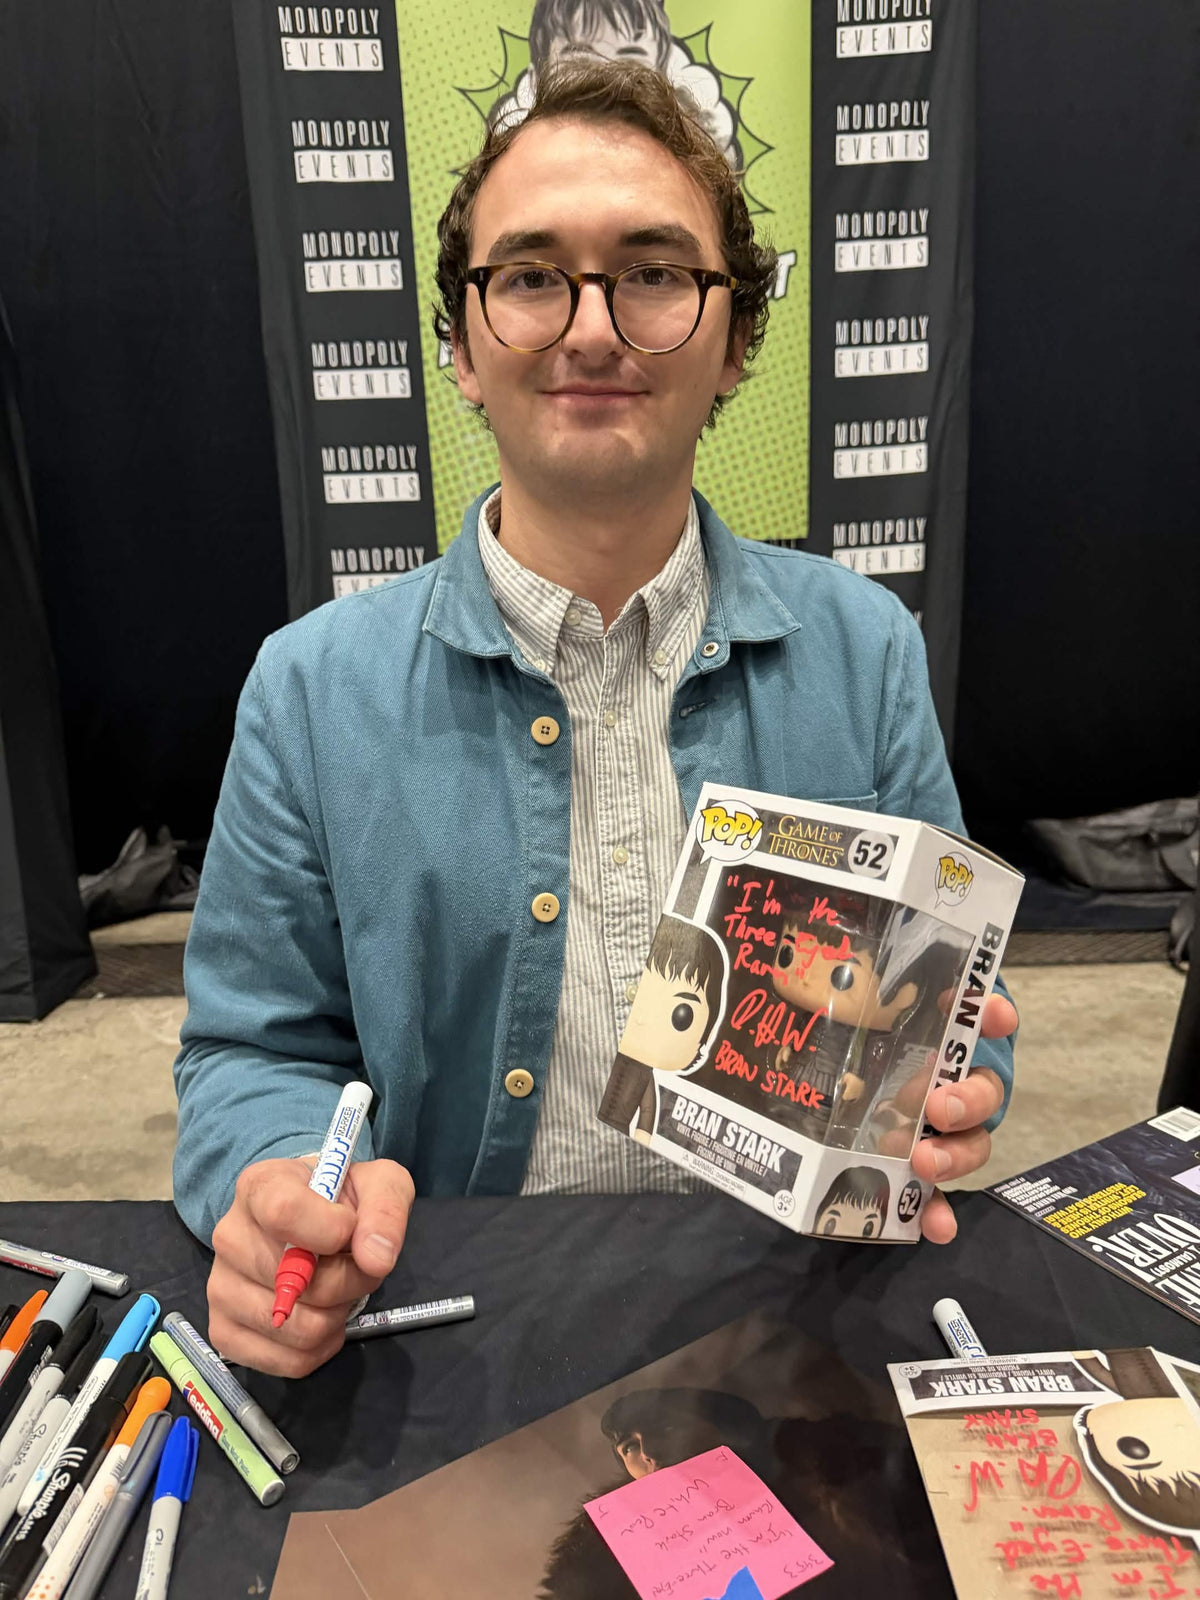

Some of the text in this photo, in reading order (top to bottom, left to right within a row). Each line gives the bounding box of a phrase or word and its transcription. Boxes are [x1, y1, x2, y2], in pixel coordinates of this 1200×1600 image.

[278, 6, 380, 34] MONOPOLY
[840, 24, 928, 54] EVENTS
[284, 41, 380, 67] EVENTS
[836, 101, 929, 131] MONOPOLY
[291, 120, 390, 147] MONOPOLY
[839, 134, 925, 162] EVENTS
[297, 154, 391, 179] EVENTS
[835, 209, 928, 239] MONOPOLY
[302, 231, 399, 258] MONOPOLY
[838, 241, 924, 268] EVENTS
[308, 264, 400, 289] EVENTS
[835, 316, 929, 346] MONOPOLY
[311, 340, 408, 368] MONOPOLY
[838, 346, 924, 375] EVENTS
[317, 372, 408, 397] EVENTS
[834, 416, 928, 448] MONOPOLY
[321, 446, 417, 472] MONOPOLY
[836, 448, 923, 476] EVENTS
[327, 476, 418, 498] EVENTS
[833, 518, 926, 547] MONOPOLY
[331, 547, 424, 572] MONOPOLY
[700, 806, 762, 850] POP!
[778, 816, 844, 844] GAME OF
[768, 832, 842, 867] THRONES
[852, 840, 887, 870] 52
[938, 856, 974, 896] POP!
[955, 922, 1004, 1029] BRAN
[715, 1040, 824, 1110] BRAN STARK
[338, 1106, 354, 1138] MARKER
[671, 1096, 786, 1173] BRAN STARK
[778, 1190, 794, 1206] AGE
[778, 1201, 788, 1213] 3+
[899, 1188, 920, 1216] 52
[1081, 1182, 1127, 1206] WESTEROS
[1108, 1190, 1147, 1211] SEASONS
[1060, 1211, 1100, 1234] THRONES
[1068, 1205, 1133, 1240] WITH ONLY TWO
[1097, 1207, 1111, 1216] OF
[1085, 1213, 1200, 1284] OVER!
[1150, 1250, 1198, 1278] (ALMOST)
[930, 1375, 1074, 1397] BRAN STARK
[962, 1408, 1039, 1430] STARK
[985, 1427, 1058, 1450] BRAN
[653, 1478, 710, 1517] White
[697, 1499, 736, 1523] Bran
